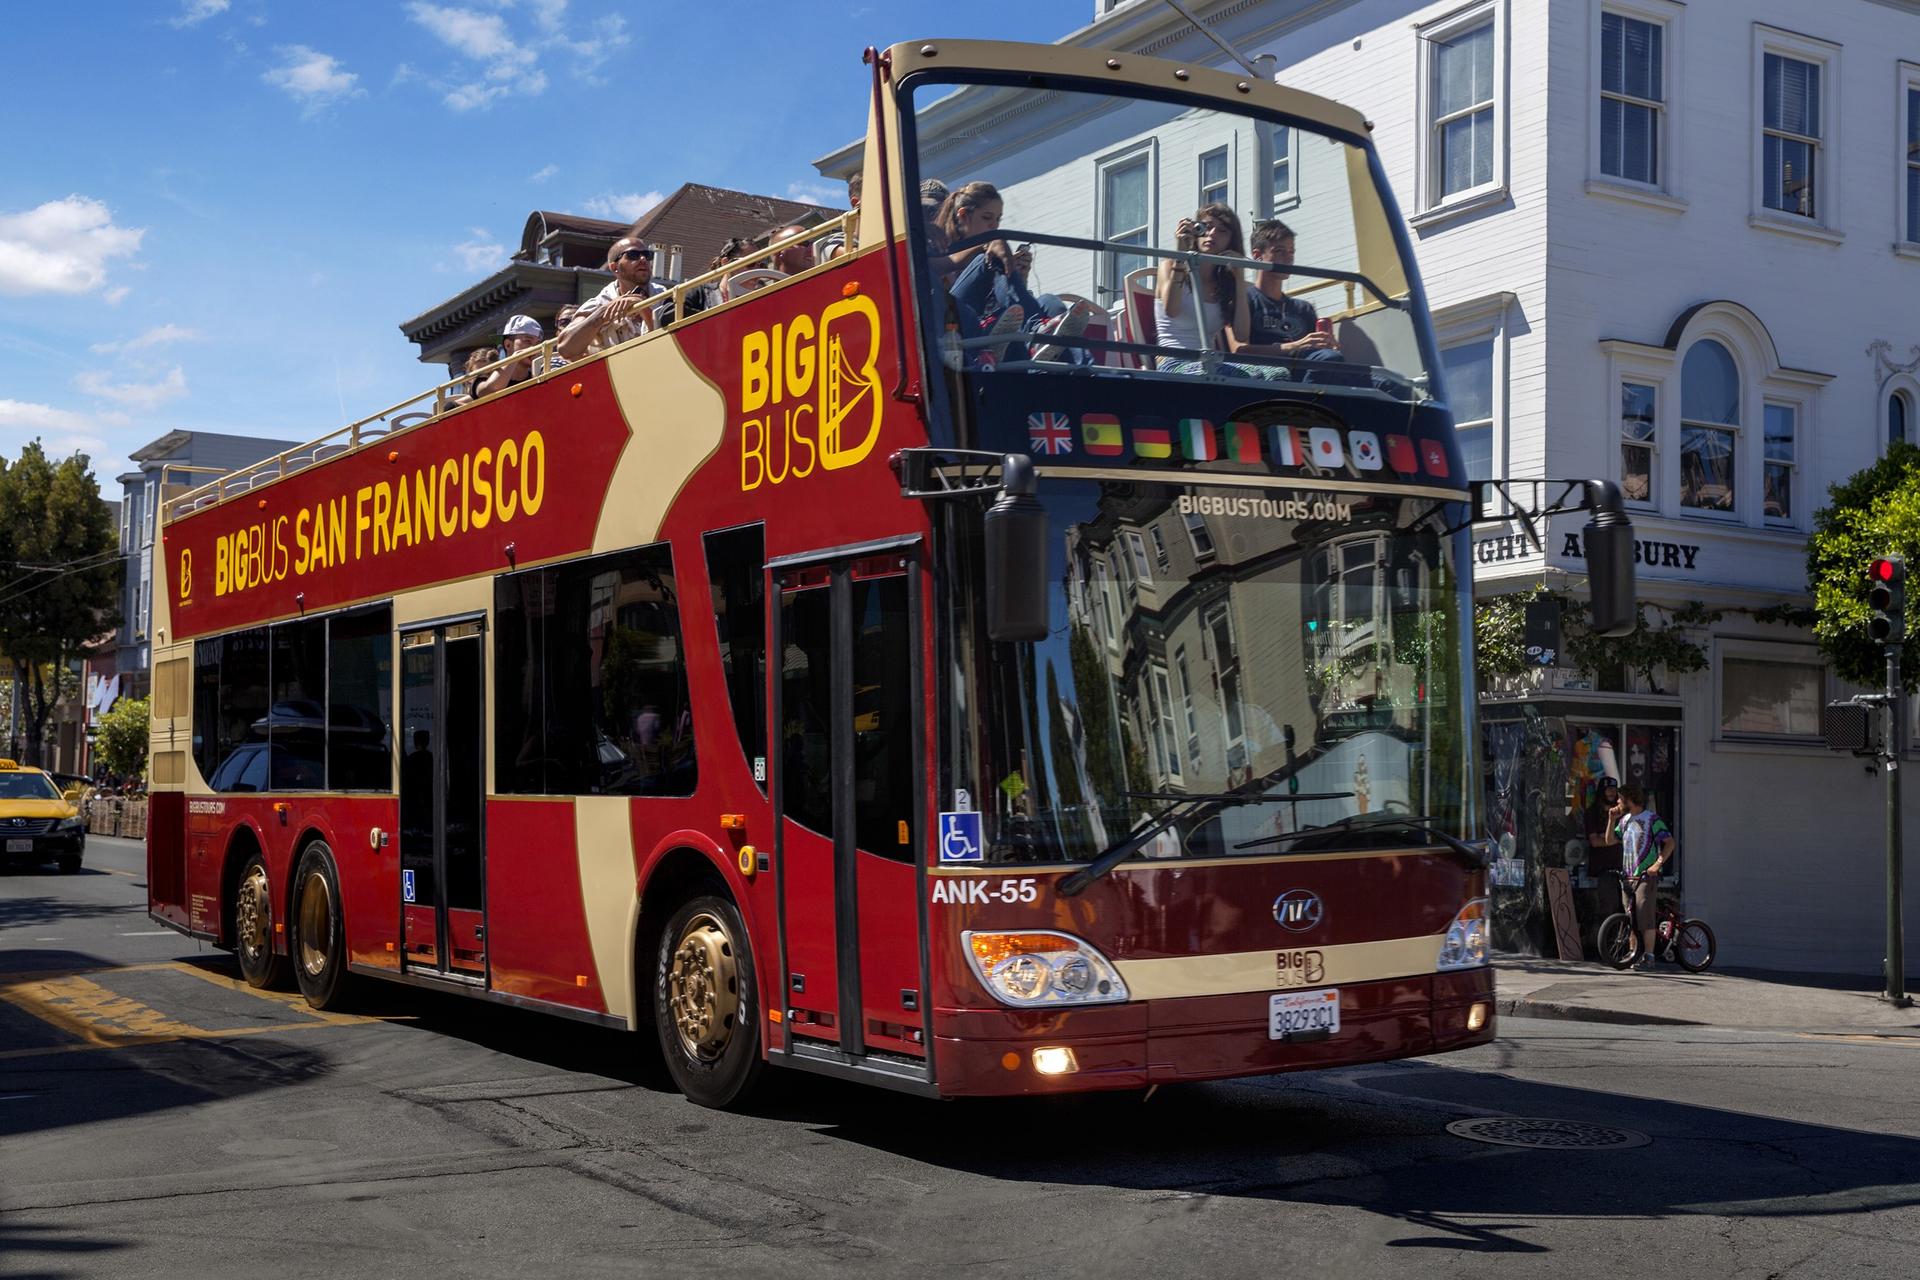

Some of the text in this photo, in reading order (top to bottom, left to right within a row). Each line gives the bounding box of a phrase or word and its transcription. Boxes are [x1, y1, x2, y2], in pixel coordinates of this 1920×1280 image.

[742, 314, 815, 413] BIG
[741, 403, 815, 491] BUS
[295, 495, 348, 576] SAN
[355, 430, 546, 560] FRANCISCO
[1178, 495, 1352, 522] BIGBUSTOURS.COM
[958, 790, 967, 805] 2
[931, 879, 1038, 904] ANK-55
[1276, 951, 1303, 970] BIG
[1276, 969, 1303, 987] BUS
[1274, 1005, 1336, 1032] 38293C1
